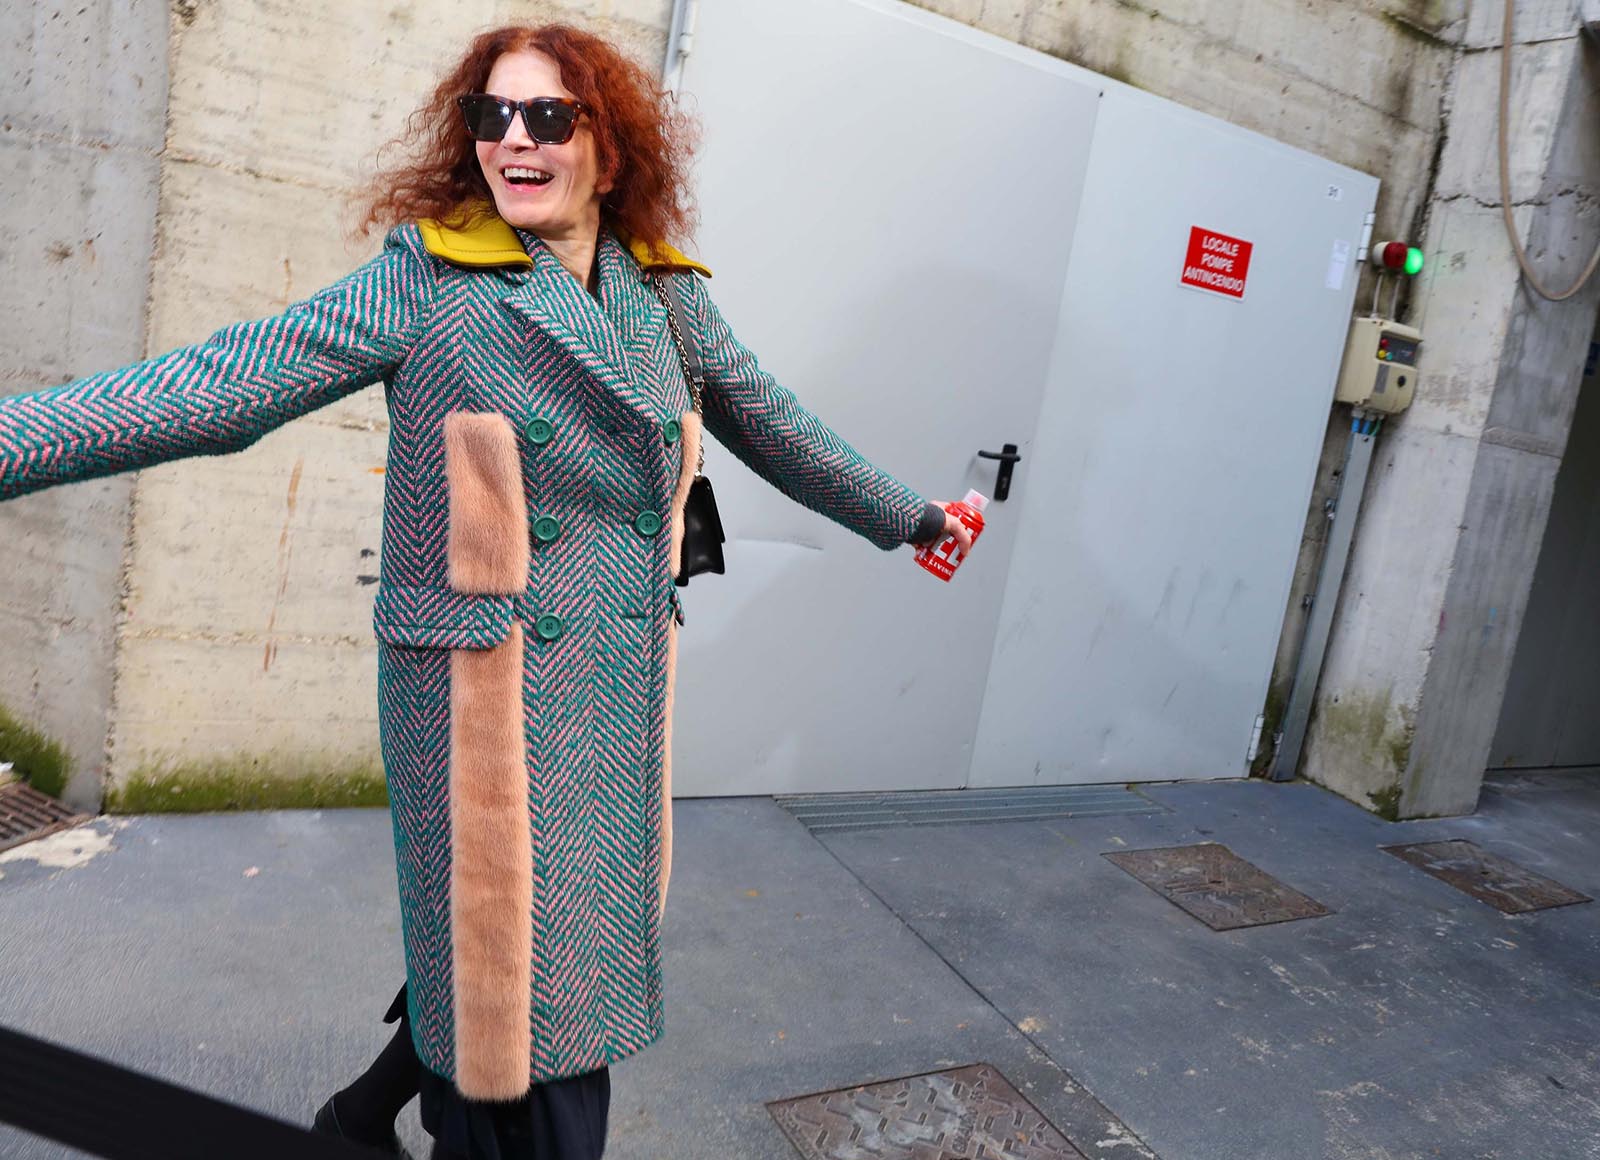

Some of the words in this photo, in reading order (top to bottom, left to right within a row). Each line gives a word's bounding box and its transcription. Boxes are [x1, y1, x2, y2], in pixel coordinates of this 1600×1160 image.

[1202, 235, 1239, 256] LOCALE
[1201, 252, 1234, 272] POMPE
[1184, 265, 1244, 292] ANTINCENDIO
